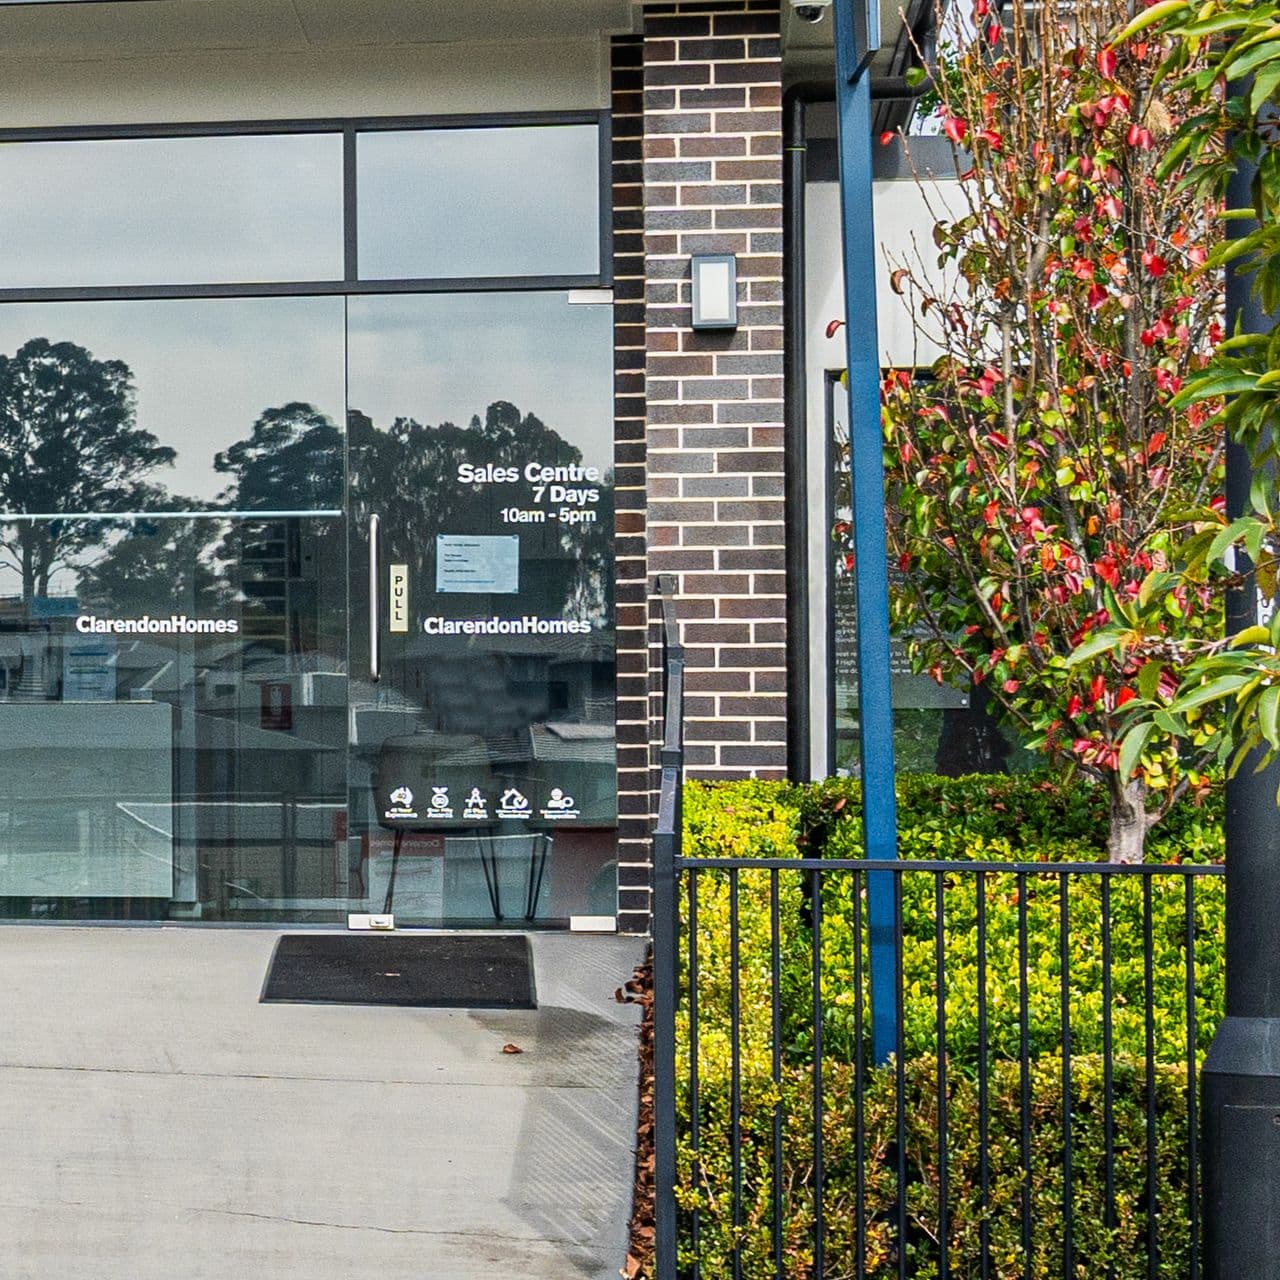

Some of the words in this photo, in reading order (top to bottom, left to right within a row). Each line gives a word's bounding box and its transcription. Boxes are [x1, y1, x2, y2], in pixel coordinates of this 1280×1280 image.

[457, 463, 520, 483] Sales
[524, 462, 599, 482] Centre
[532, 486, 546, 502] 7
[550, 486, 600, 505] Days
[500, 507, 545, 523] 10am
[559, 507, 597, 525] 5pm
[75, 616, 239, 633] ClarendonHomes
[423, 616, 591, 634] ClarendonHomes
